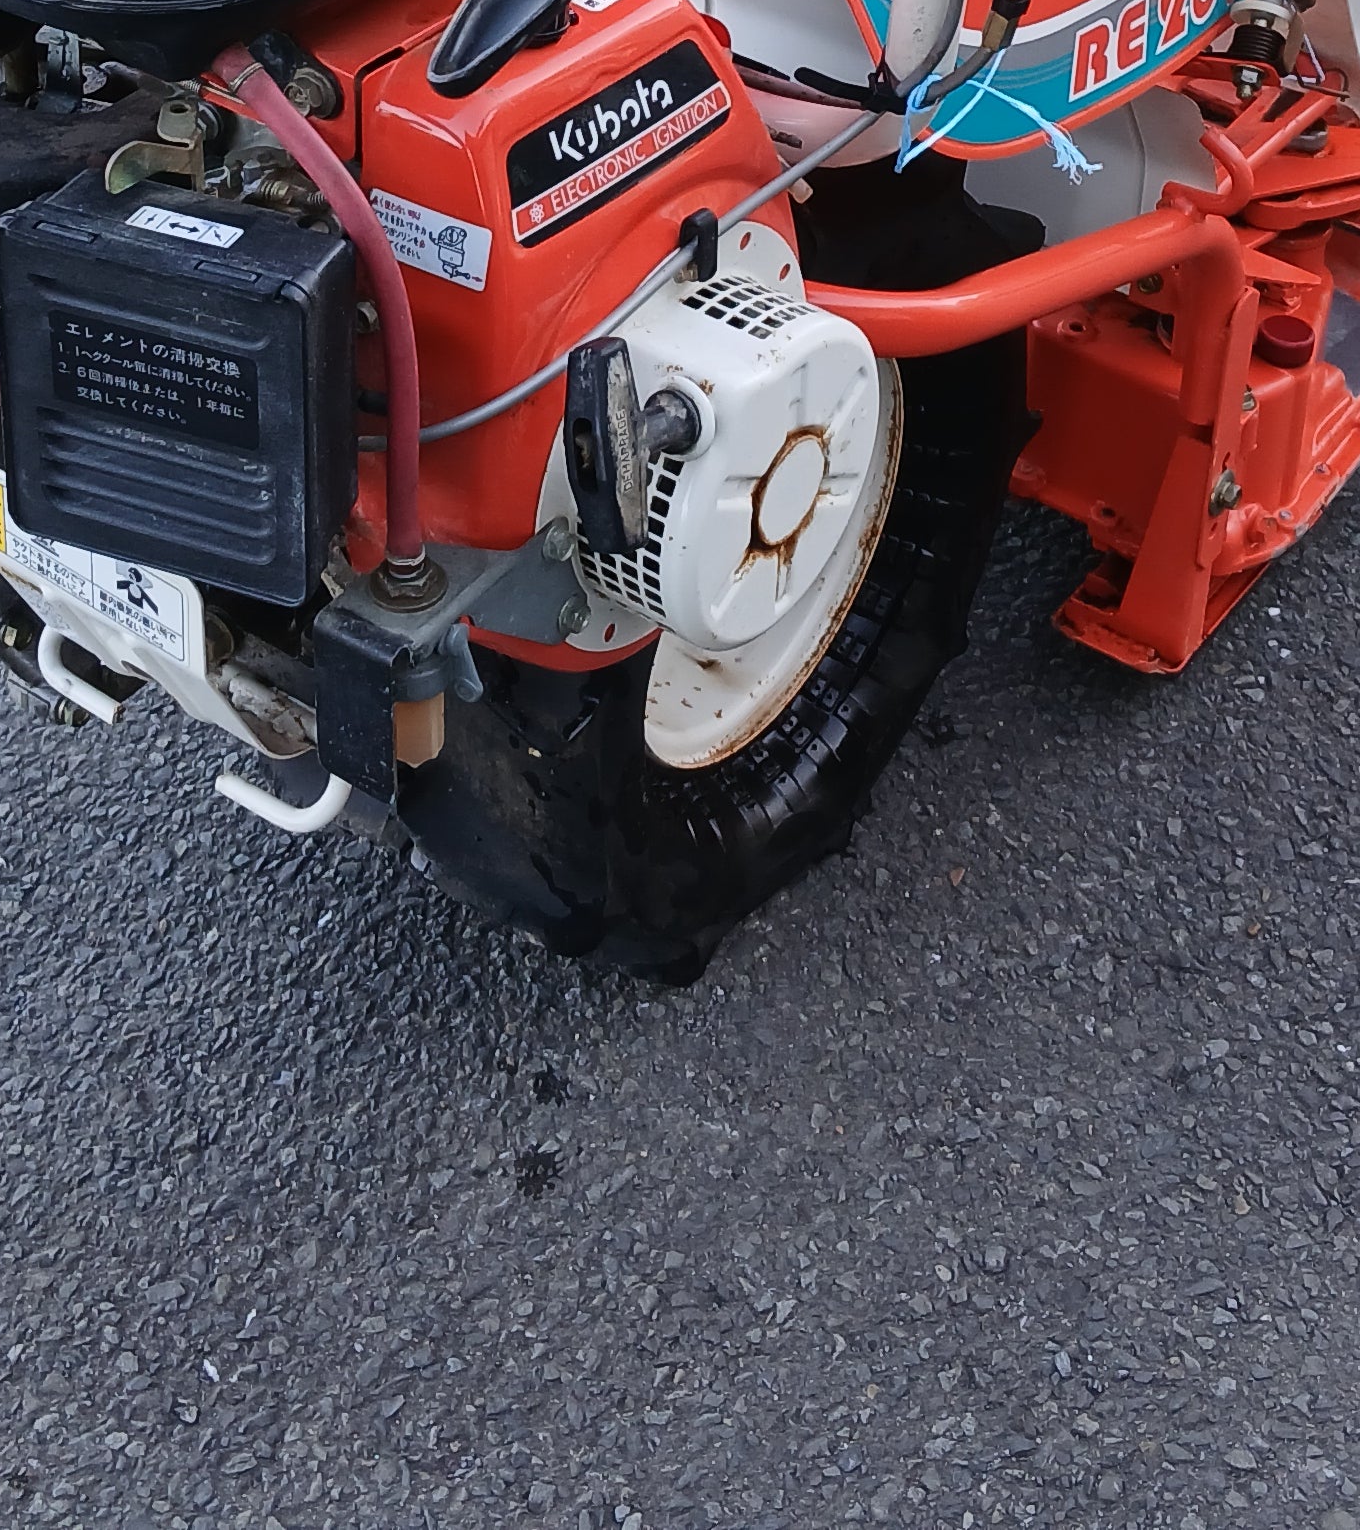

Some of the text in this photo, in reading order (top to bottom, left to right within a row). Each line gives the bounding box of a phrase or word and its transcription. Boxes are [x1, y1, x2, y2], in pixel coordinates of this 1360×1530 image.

[548, 78, 674, 162] Kubota
[550, 93, 719, 213] ELECTRONIC IGNITION
[66, 322, 242, 379] エレメントの清掃交換
